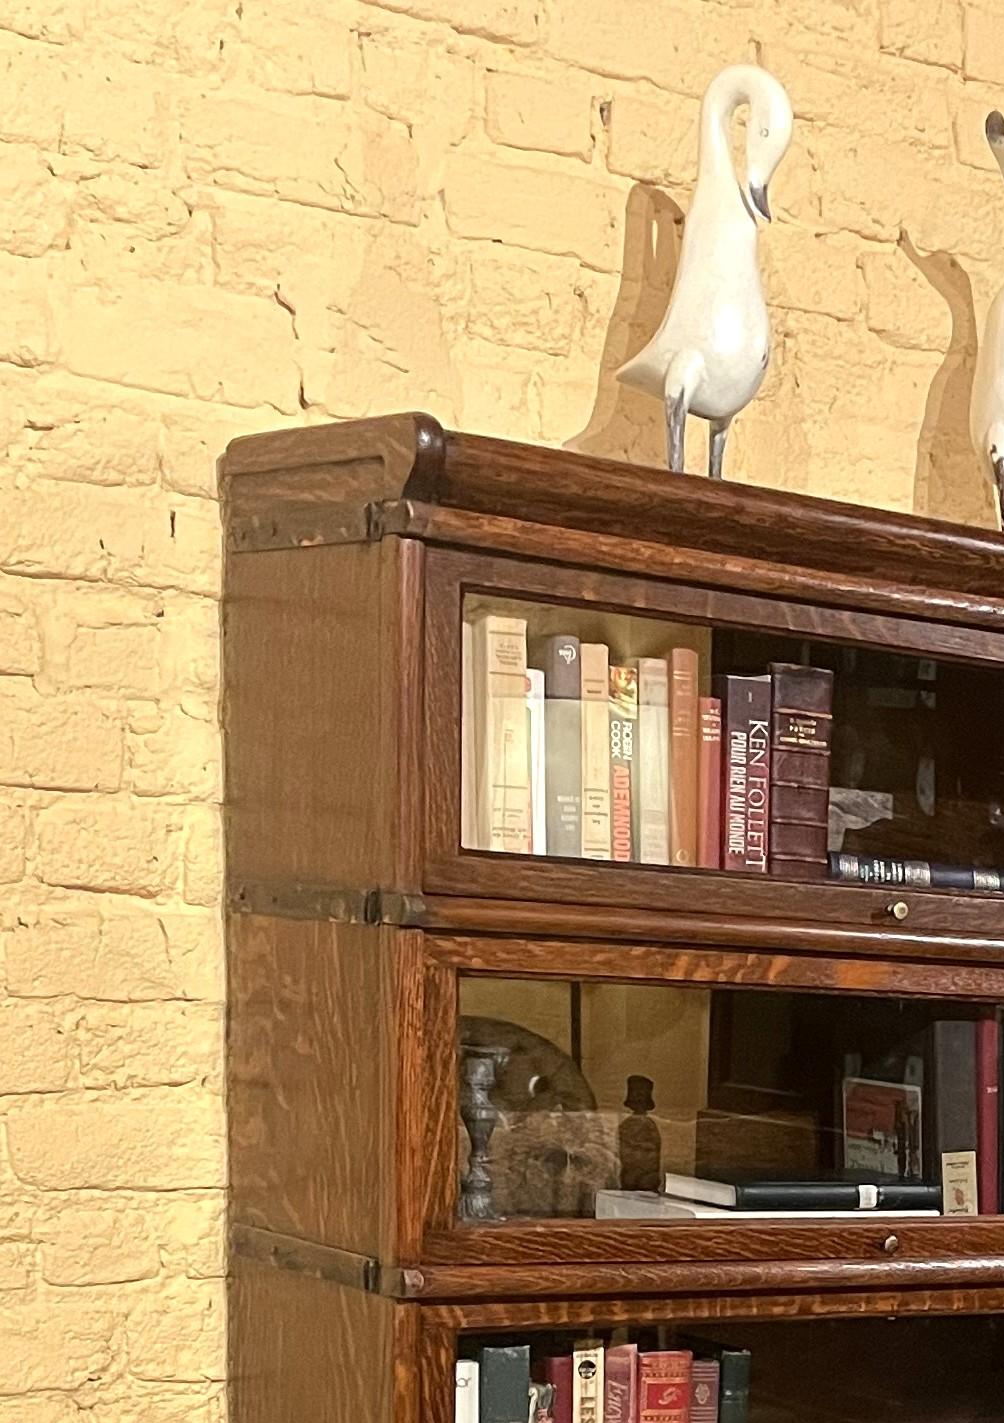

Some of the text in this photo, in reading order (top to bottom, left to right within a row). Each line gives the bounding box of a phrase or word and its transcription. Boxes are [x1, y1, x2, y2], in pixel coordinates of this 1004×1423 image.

[610, 721, 621, 758] COOK
[622, 721, 633, 761] ROBIN
[612, 765, 631, 862] ADEMNOOD
[728, 731, 748, 855] POUR RIEN AU MONDE
[745, 719, 768, 873] KEN FOLLETT
